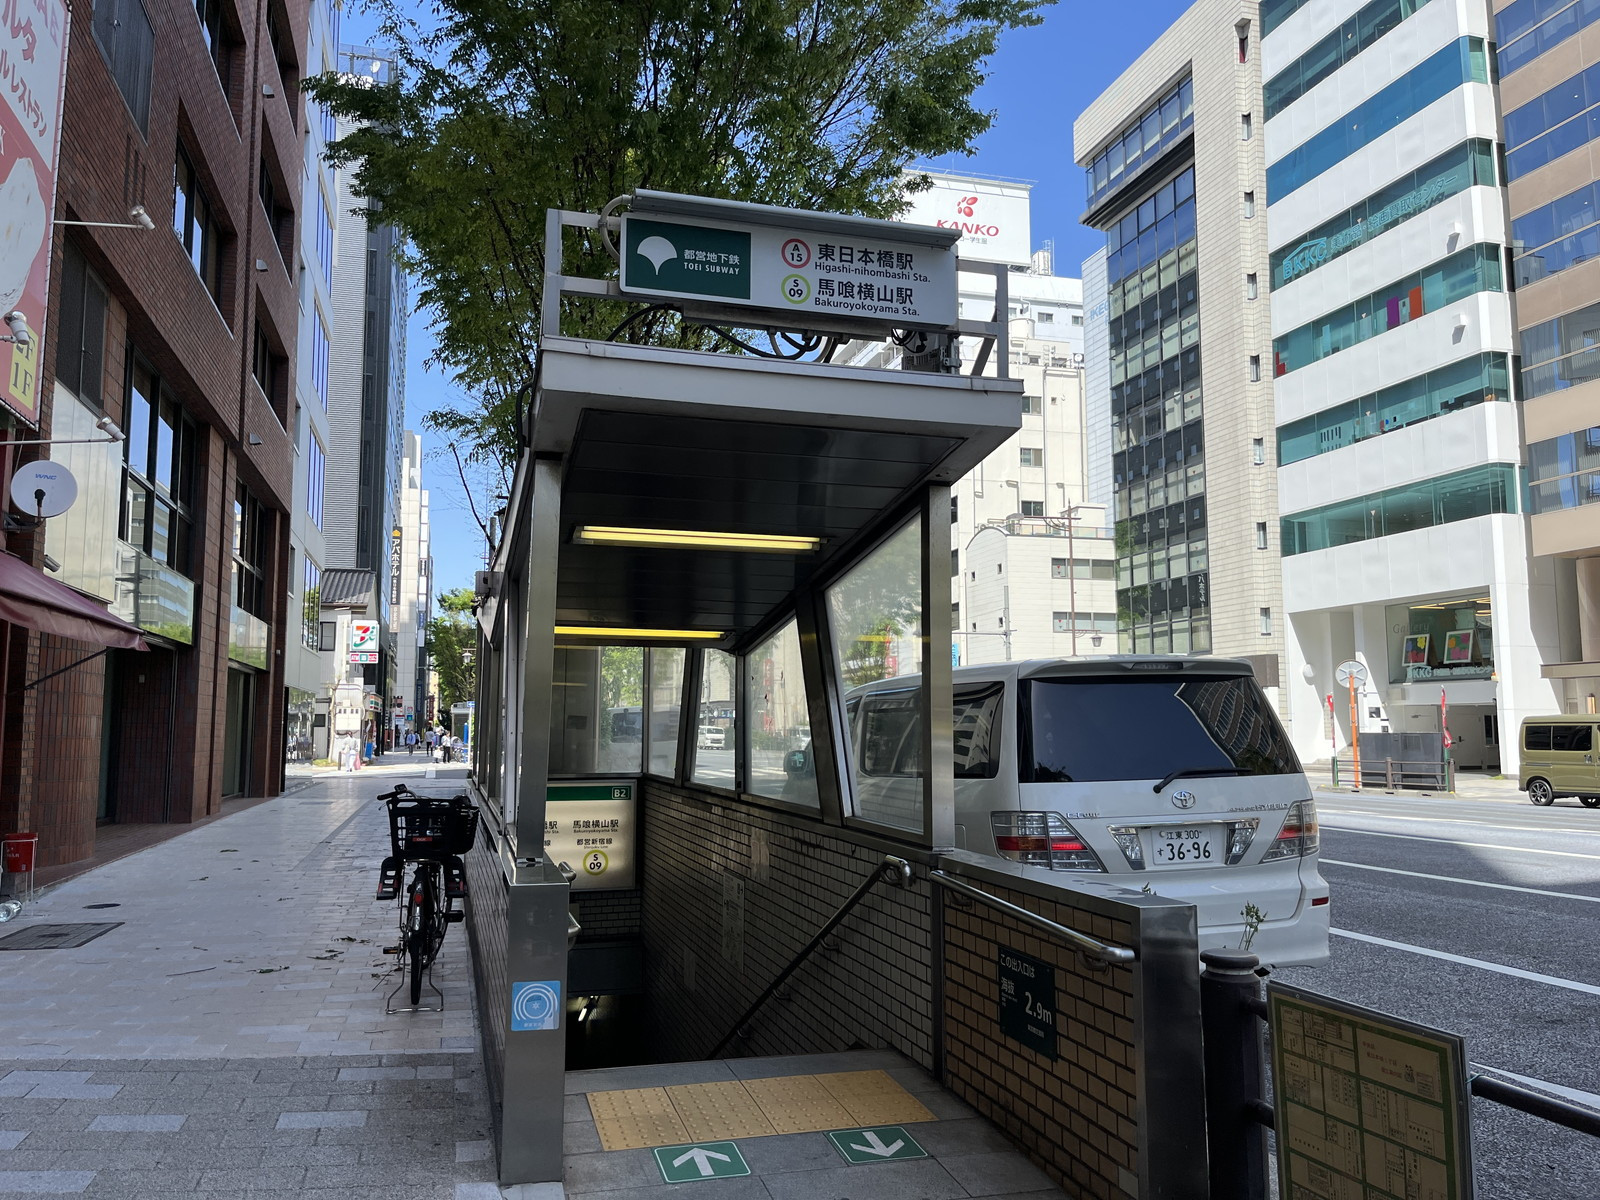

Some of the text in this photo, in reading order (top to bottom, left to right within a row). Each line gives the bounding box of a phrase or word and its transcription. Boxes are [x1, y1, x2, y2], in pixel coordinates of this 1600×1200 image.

[936, 219, 1000, 237] KANKO
[792, 243, 800, 252] A
[683, 249, 740, 265] 都営地下鉄
[790, 252, 803, 262] 15
[817, 243, 914, 271] 東日本橋駅
[1283, 242, 1327, 280] BKKC
[684, 262, 740, 275] TOEI SUBWAY
[815, 261, 931, 283] Higashi-nihombashi Sta.
[793, 278, 799, 288] S
[788, 288, 803, 298] 09
[817, 278, 914, 306] 馬喰横山駅
[814, 297, 920, 317] Bakuroyokoyama Sta.
[13, 362, 33, 398] 1F
[391, 538, 401, 577] アパホテル
[614, 789, 627, 798] B2
[573, 819, 619, 829] 馬喰横山駅
[577, 838, 613, 846] 都営新宿線
[1166, 829, 1200, 840] 江東 300
[593, 853, 599, 861] S
[1166, 841, 1211, 861] 36-96
[589, 861, 602, 870] 09
[1000, 953, 1036, 979] この出入口は
[1024, 991, 1053, 1025] 2.9m
